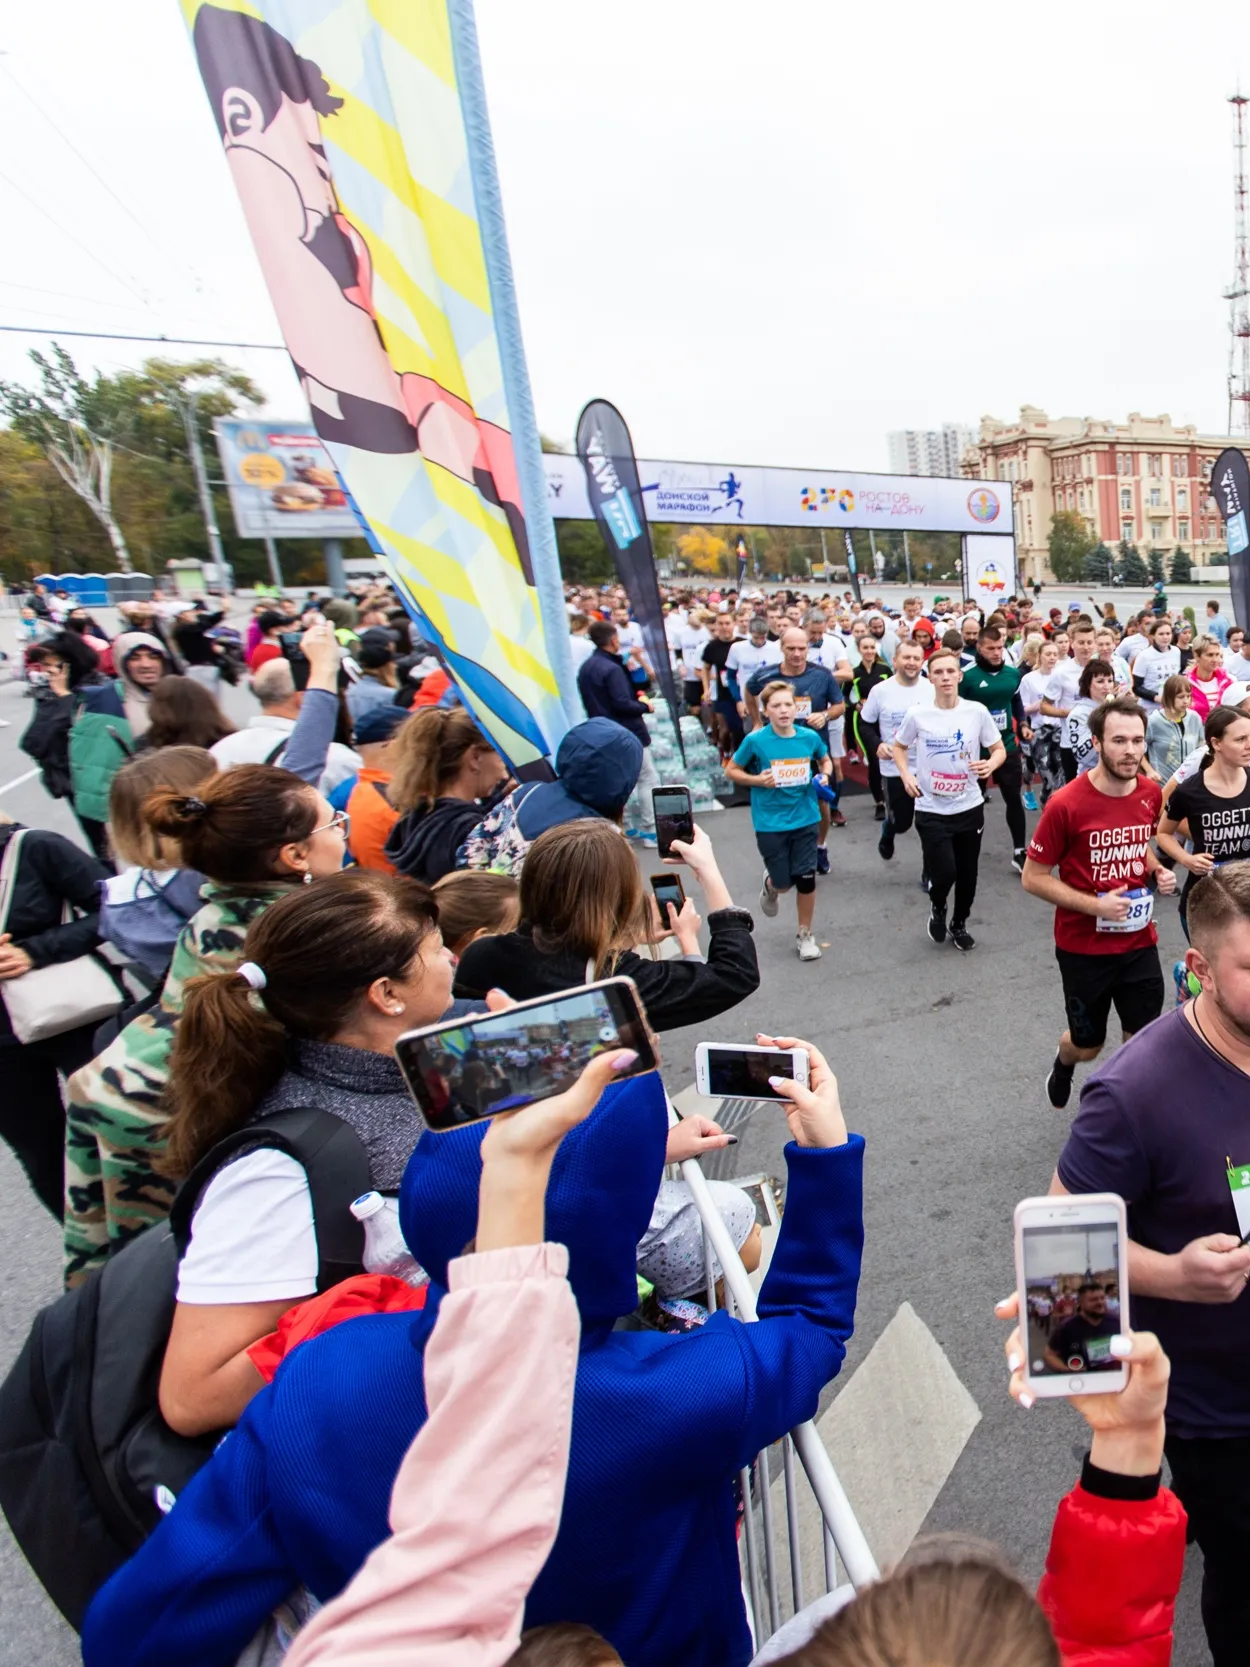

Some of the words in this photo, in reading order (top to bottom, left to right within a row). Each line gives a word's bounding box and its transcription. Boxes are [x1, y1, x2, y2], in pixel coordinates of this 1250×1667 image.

[656, 491, 709, 501] ДОНСКОЙ
[859, 491, 910, 503] РОСТОВ
[657, 502, 710, 511] МАРАФОН
[778, 767, 806, 778] 5069
[933, 781, 966, 792] 10223
[1089, 824, 1151, 847] OGGETTO
[1090, 842, 1148, 864] RUNNIN
[1203, 840, 1240, 855] TEAM
[1092, 861, 1130, 881] TEAM
[1241, 1172, 1250, 1185] 2
